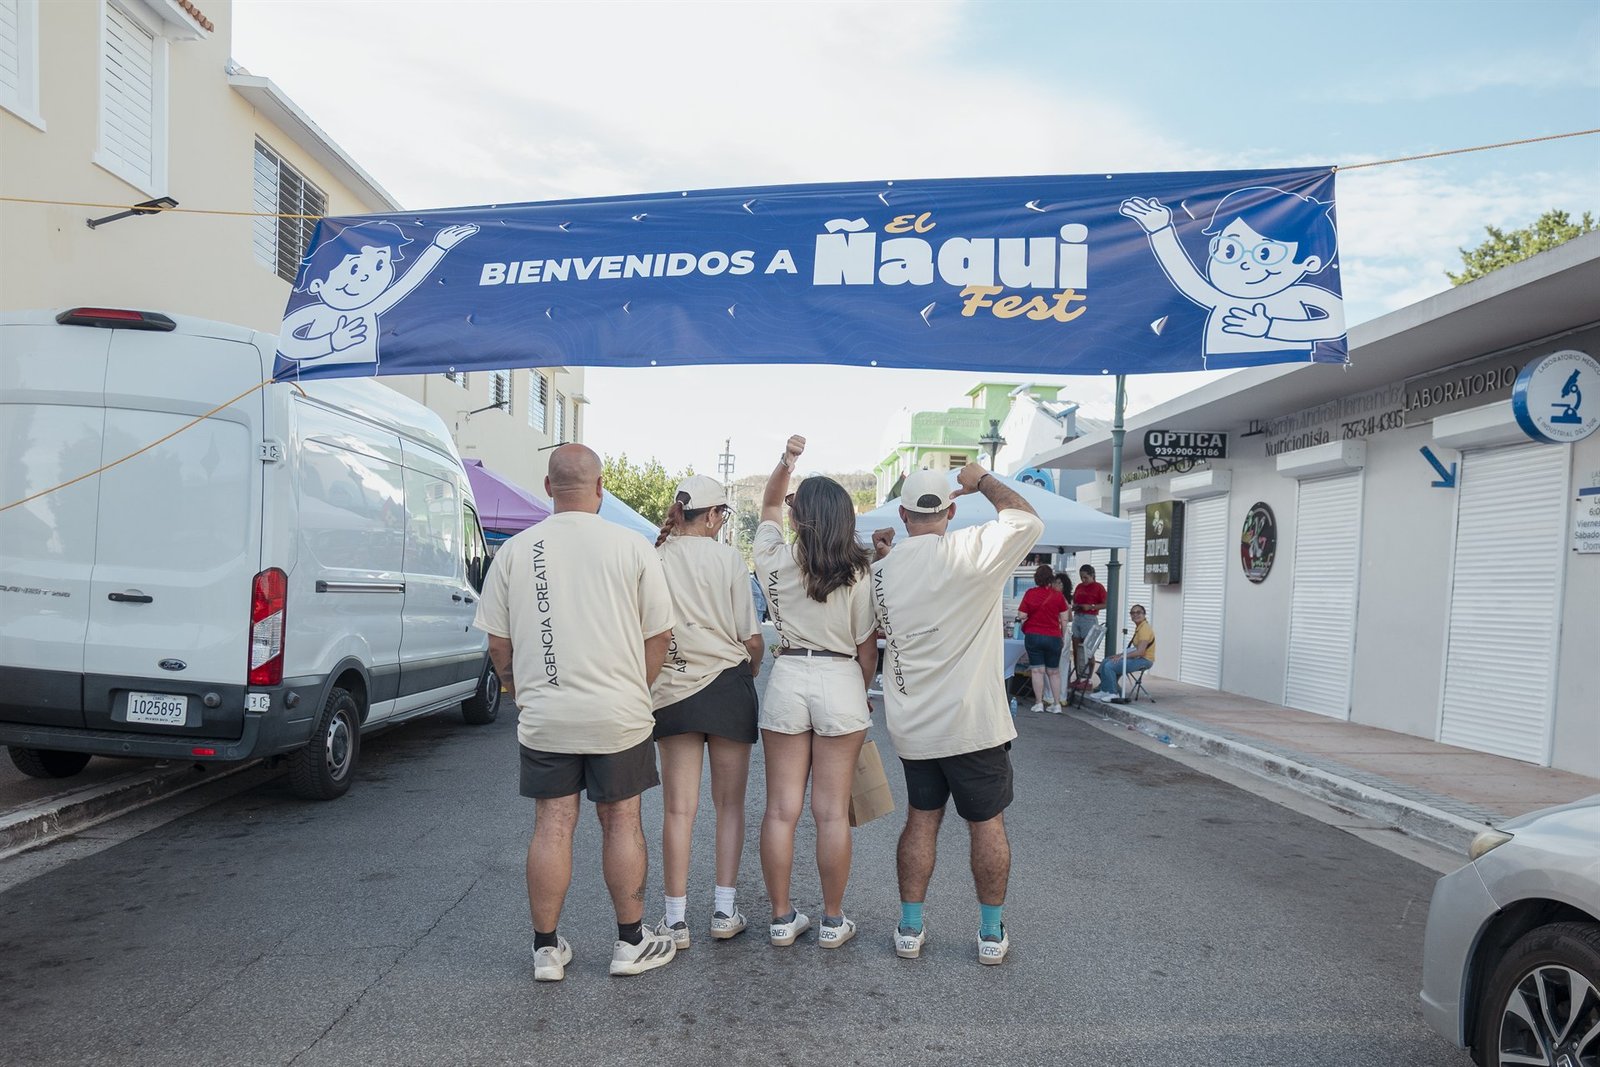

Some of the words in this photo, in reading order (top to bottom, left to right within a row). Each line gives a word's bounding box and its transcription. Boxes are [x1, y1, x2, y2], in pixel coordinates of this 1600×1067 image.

[884, 211, 936, 234] El
[479, 250, 755, 286] BIENVENIDOS
[764, 249, 798, 275] A
[813, 217, 1089, 289] Ñaqui
[959, 285, 1087, 322] Fest
[1538, 353, 1581, 374] LABORATORIO
[1404, 365, 1518, 412] LABORATORIO
[1149, 432, 1223, 448] OPTICA
[1155, 447, 1219, 456] 939-900-2186
[1265, 428, 1330, 457] Nutricionista
[533, 539, 550, 613] CREATIVA
[538, 617, 559, 687] AGENCIA
[132, 699, 182, 717] 1025895
